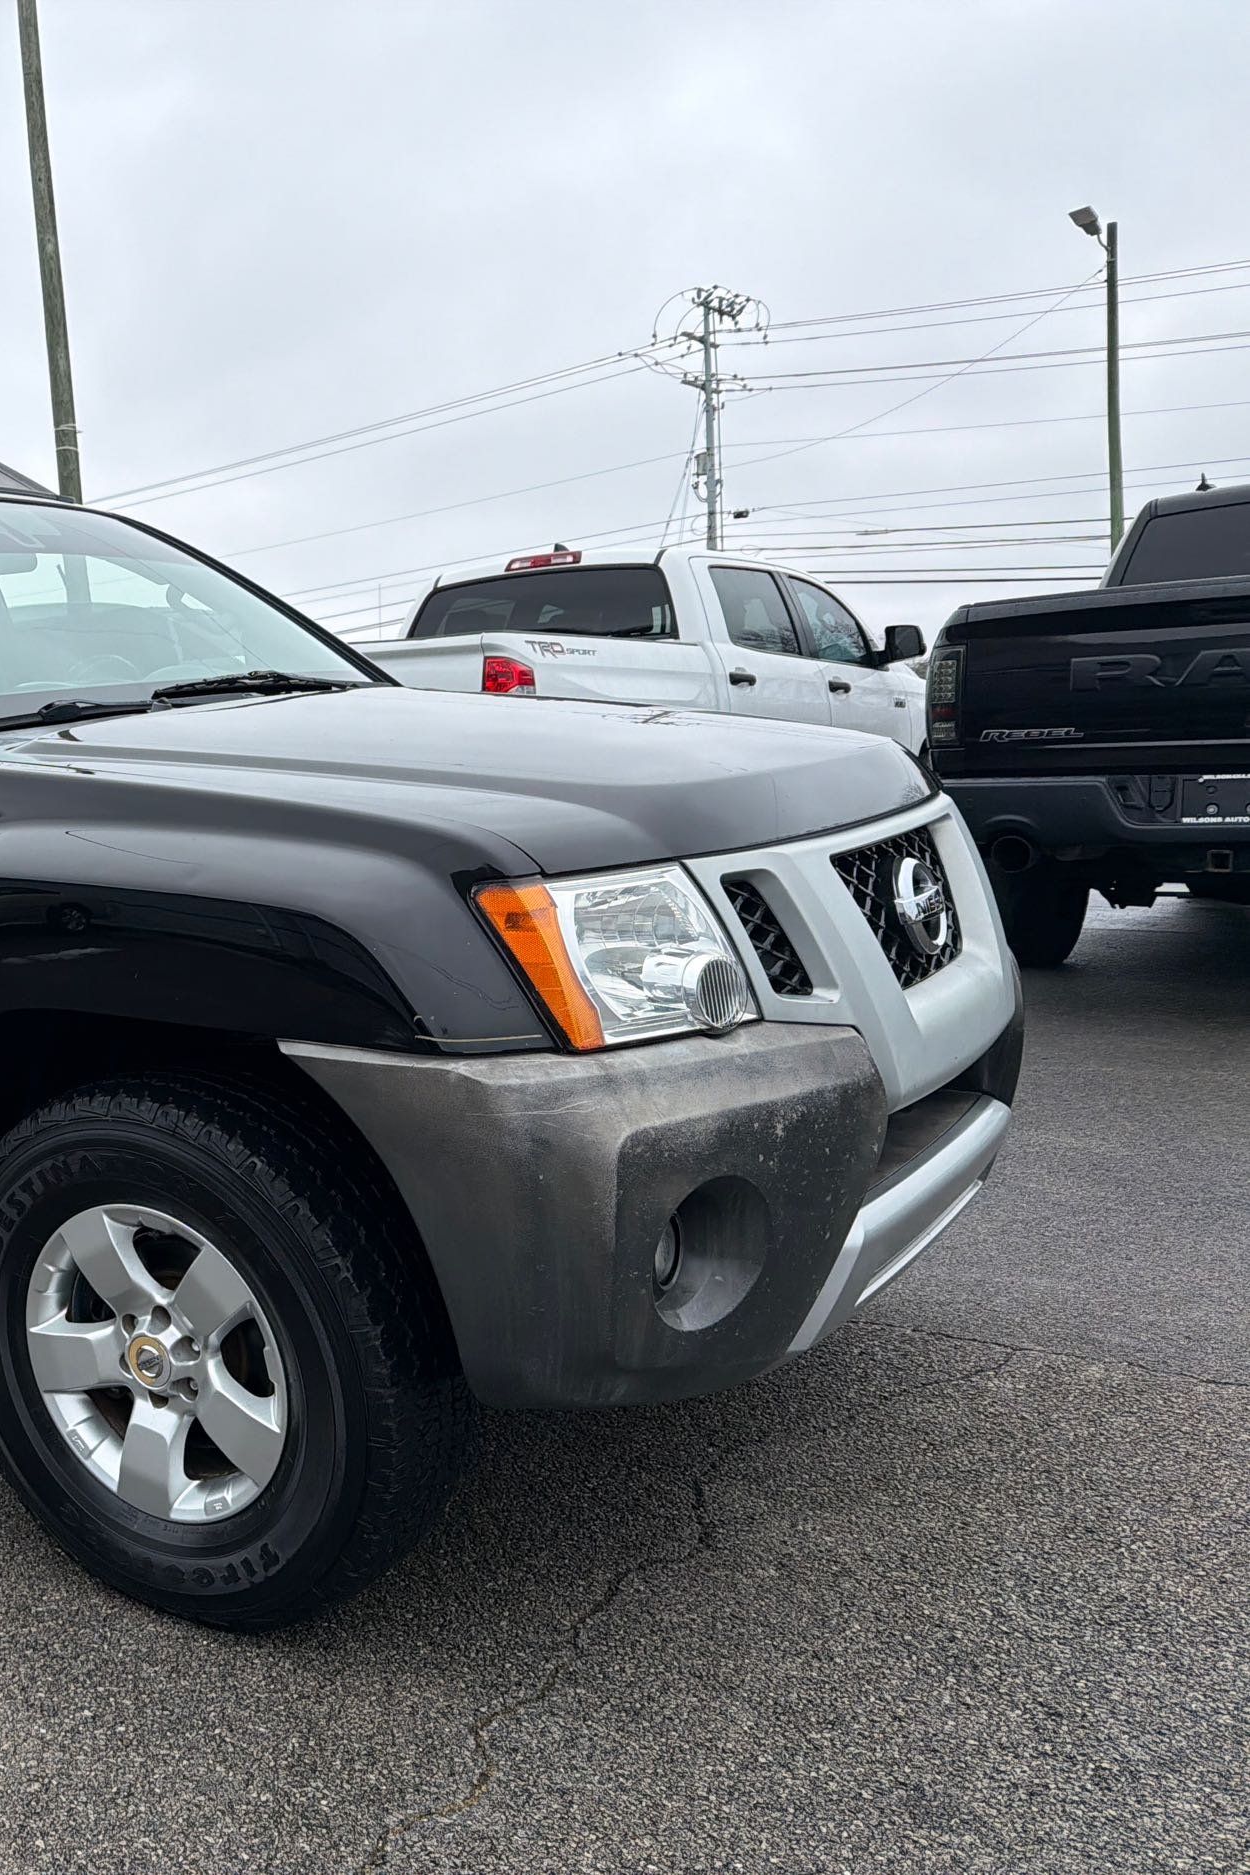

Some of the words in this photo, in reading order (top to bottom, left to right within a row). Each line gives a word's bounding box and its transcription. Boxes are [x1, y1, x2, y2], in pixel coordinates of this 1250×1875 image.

[525, 639, 566, 659] TRD
[566, 647, 598, 657] SPORT
[978, 727, 1085, 743] REBEL
